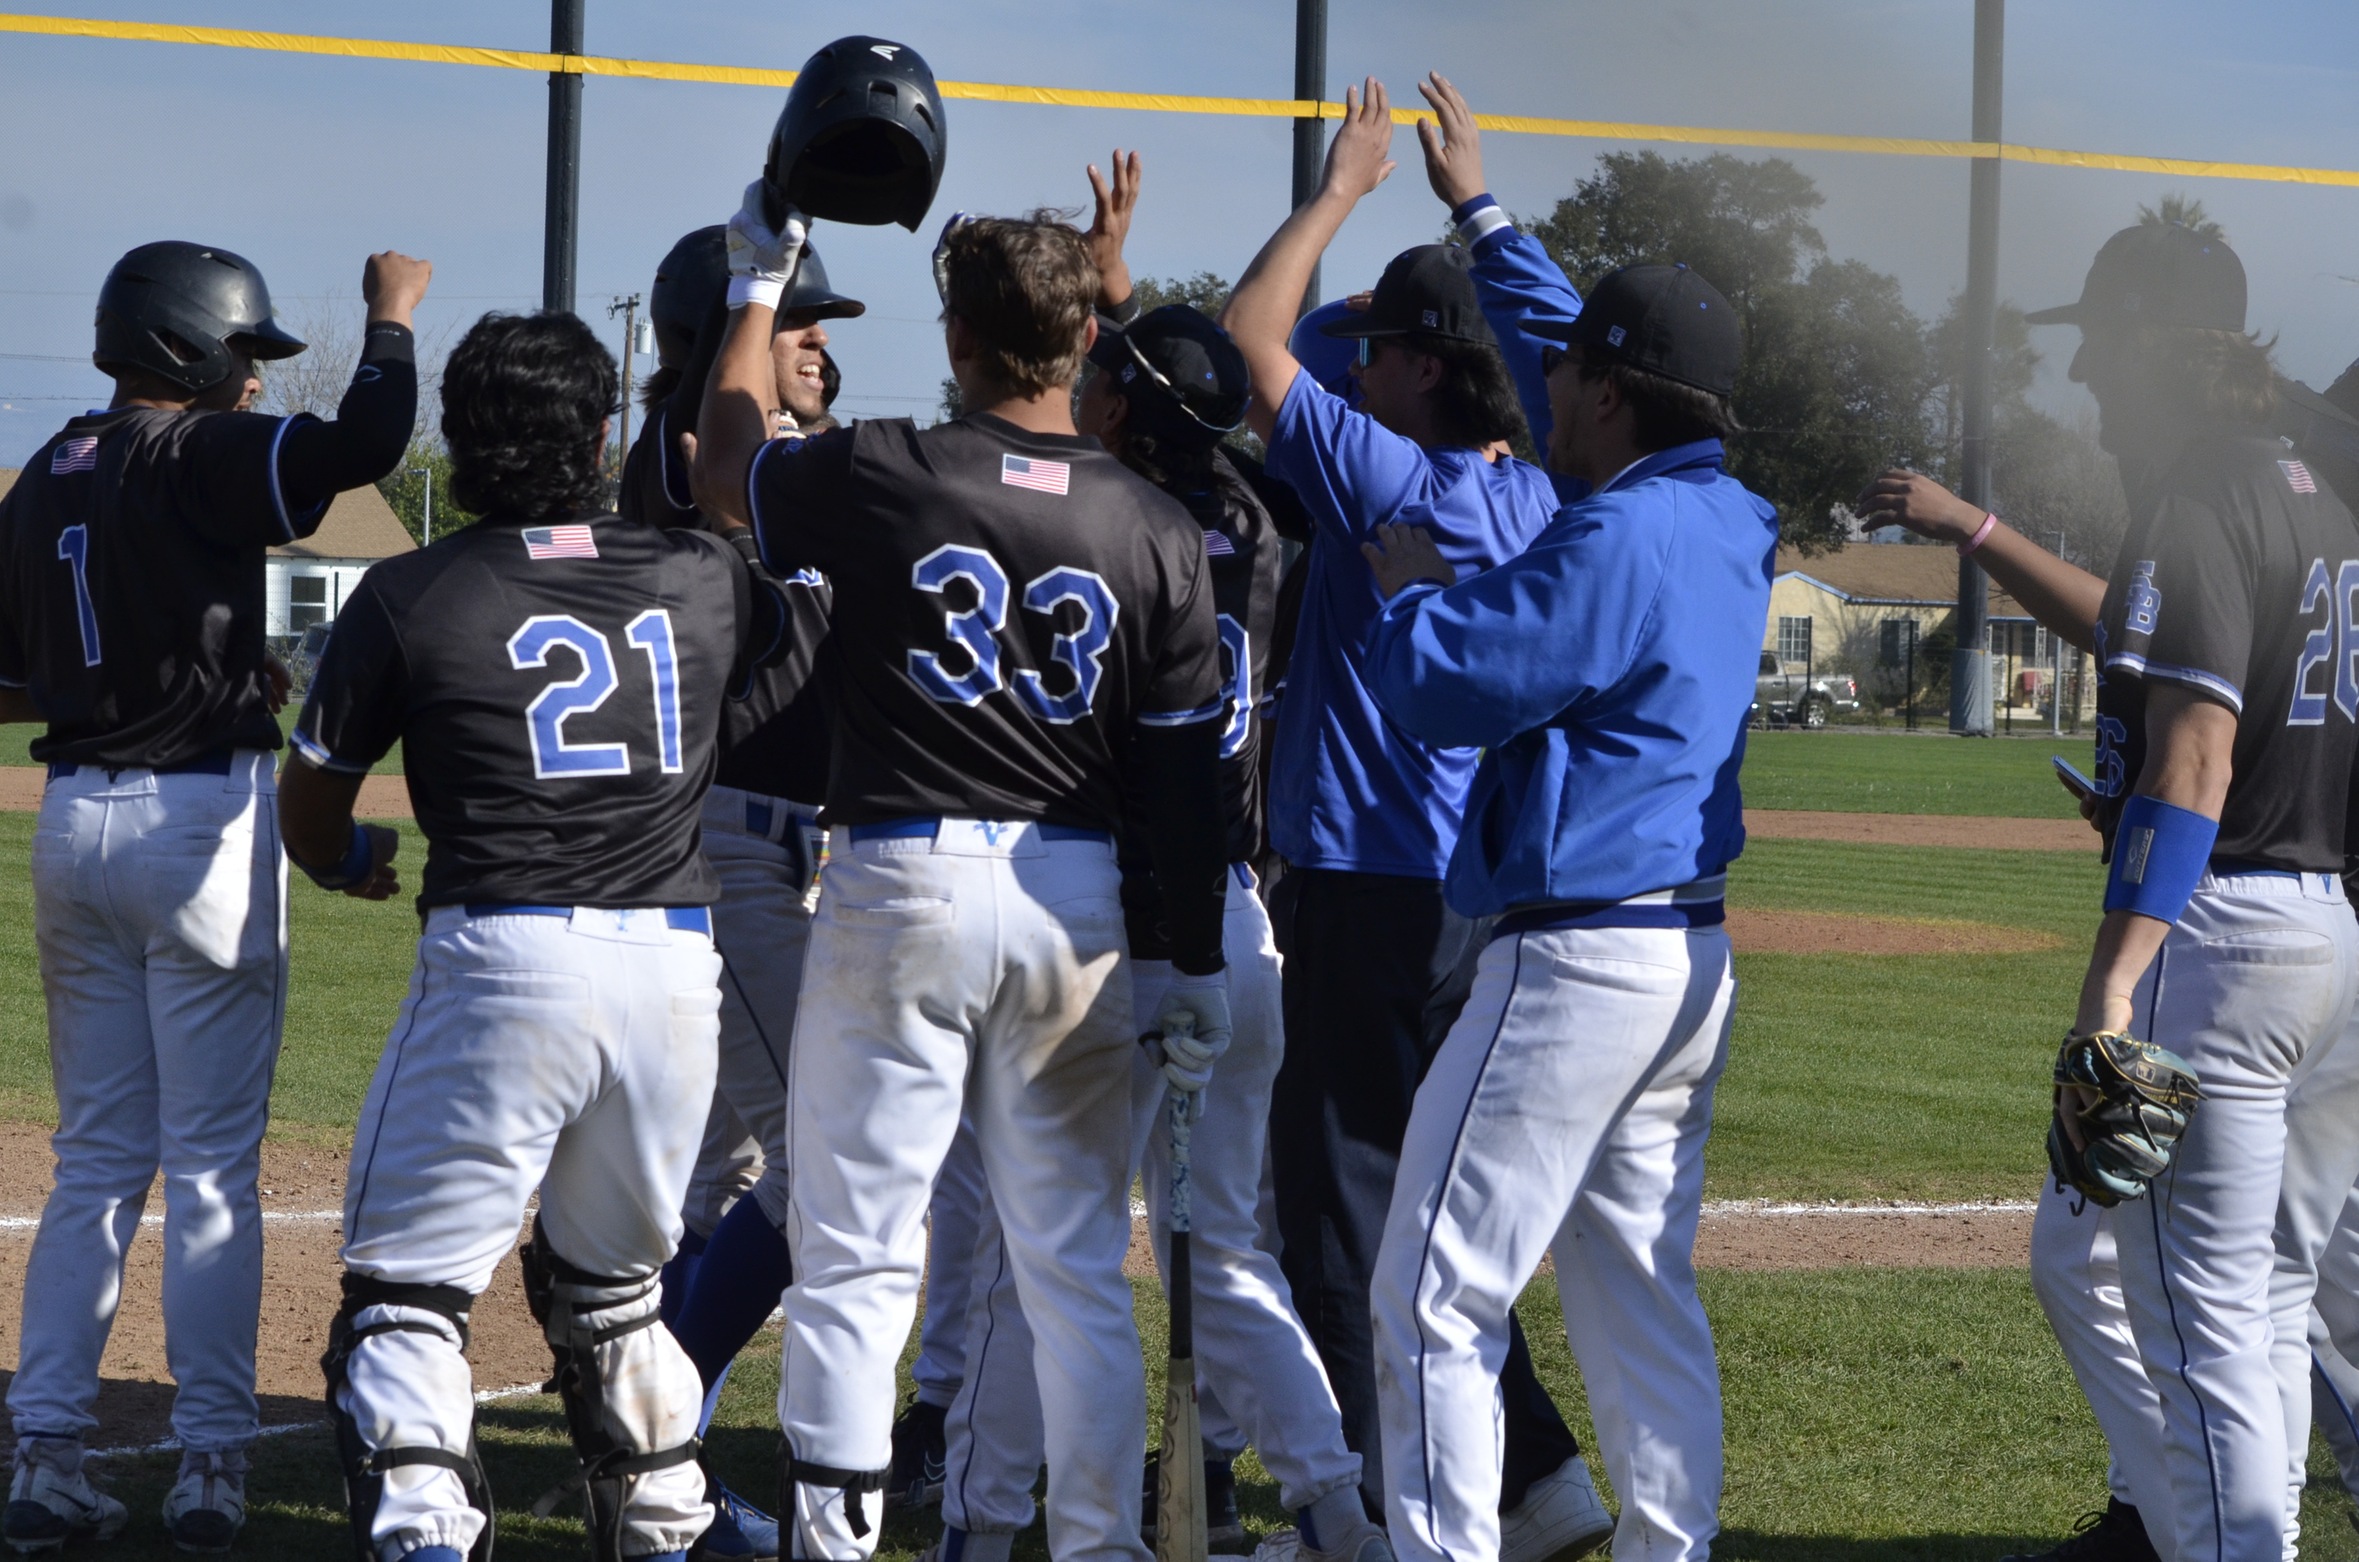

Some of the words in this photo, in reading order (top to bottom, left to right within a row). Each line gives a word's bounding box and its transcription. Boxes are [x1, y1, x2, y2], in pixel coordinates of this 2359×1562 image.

[57, 522, 102, 667] 1
[906, 542, 1120, 725] 33
[506, 608, 684, 780] 21
